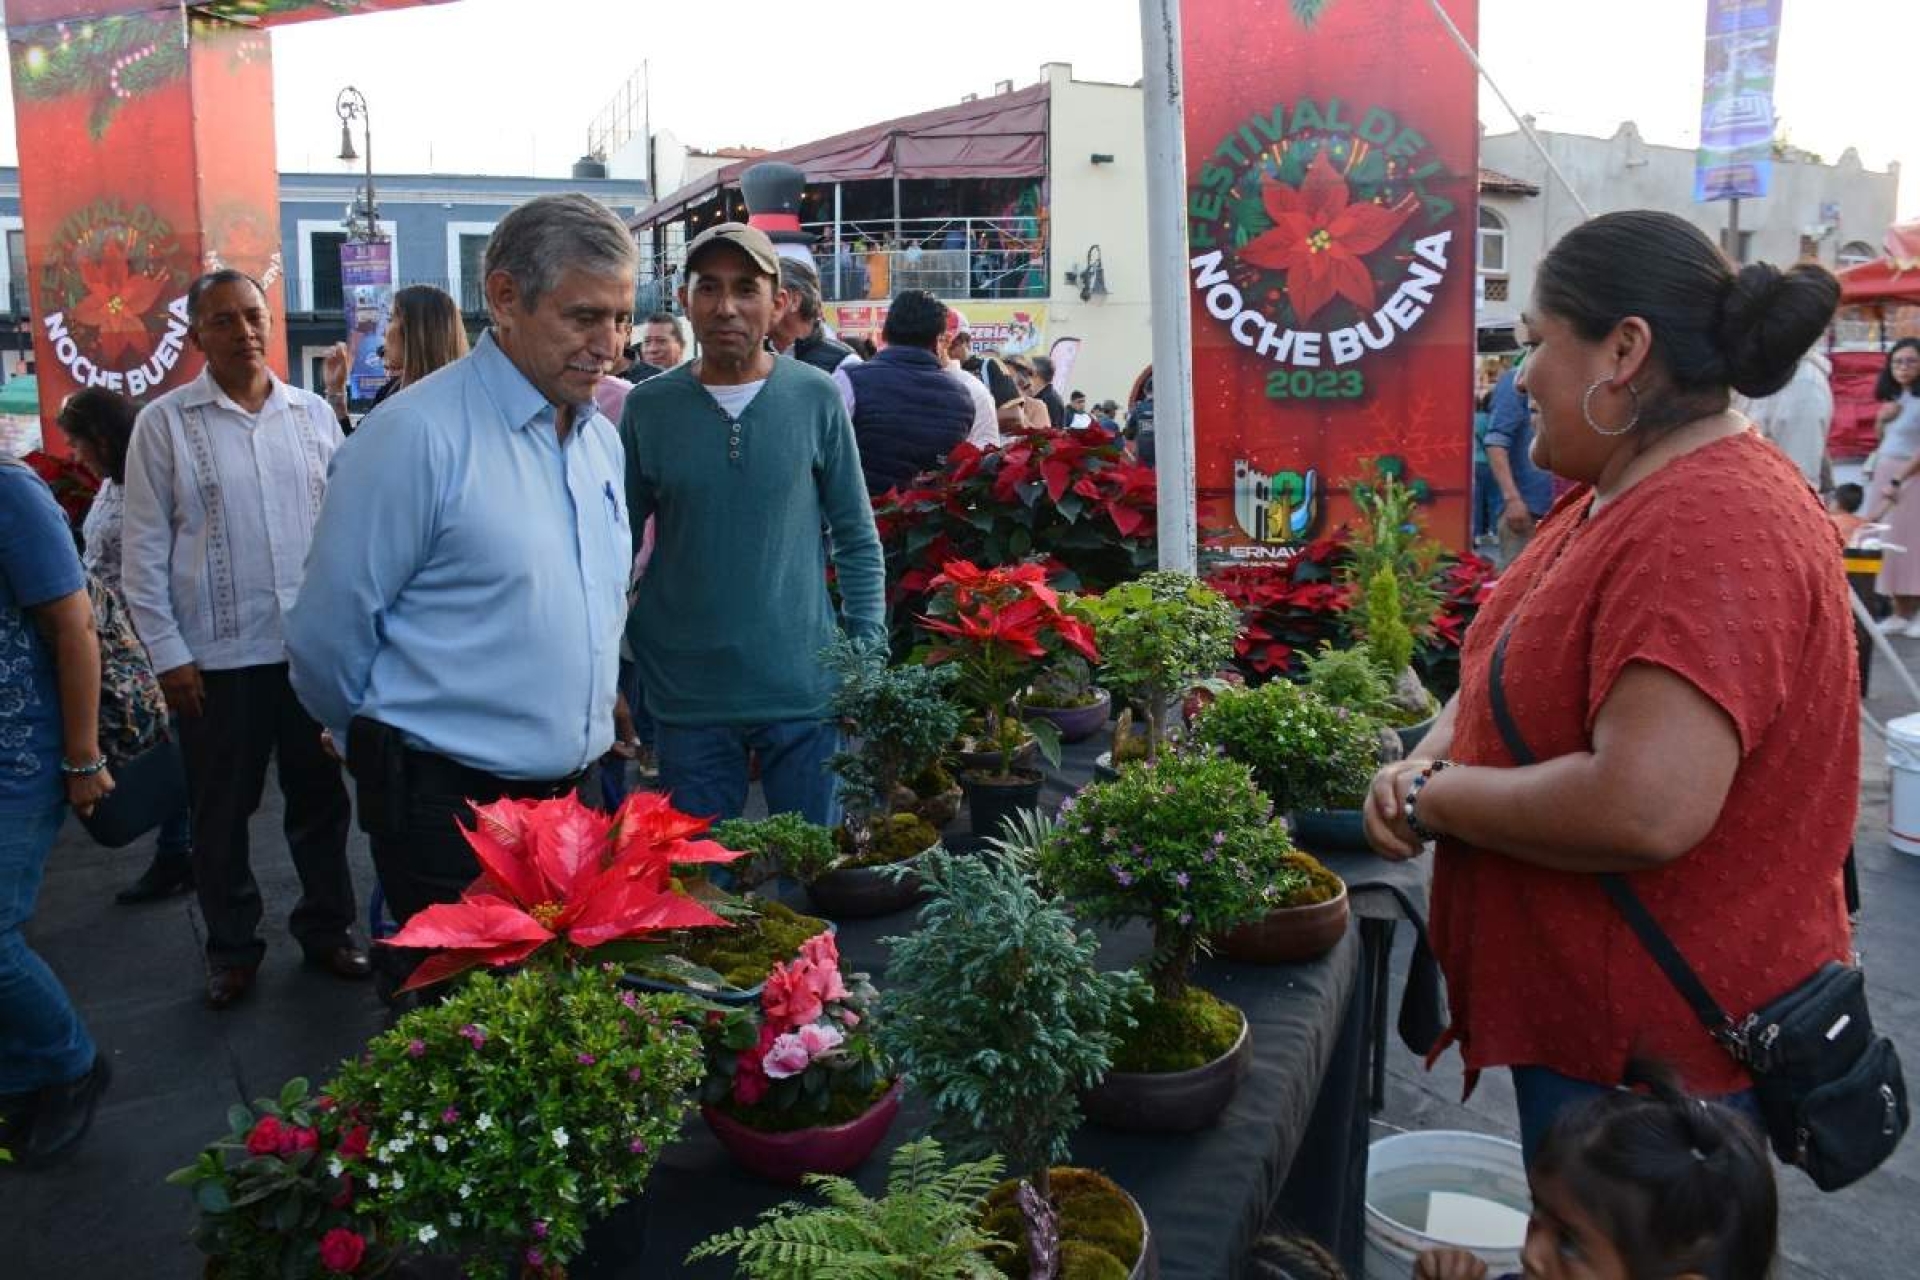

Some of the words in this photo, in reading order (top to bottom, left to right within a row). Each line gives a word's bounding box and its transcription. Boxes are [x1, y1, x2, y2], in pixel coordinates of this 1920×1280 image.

[1189, 97, 1352, 248] FESTIVAL
[1357, 106, 1428, 161] DE
[1412, 160, 1457, 229] LA
[43, 311, 124, 395] NOCHE
[126, 294, 191, 397] BUENA
[1190, 249, 1323, 367] NOCHE
[1327, 229, 1454, 366] BUENA
[1265, 370, 1364, 398] 2023
